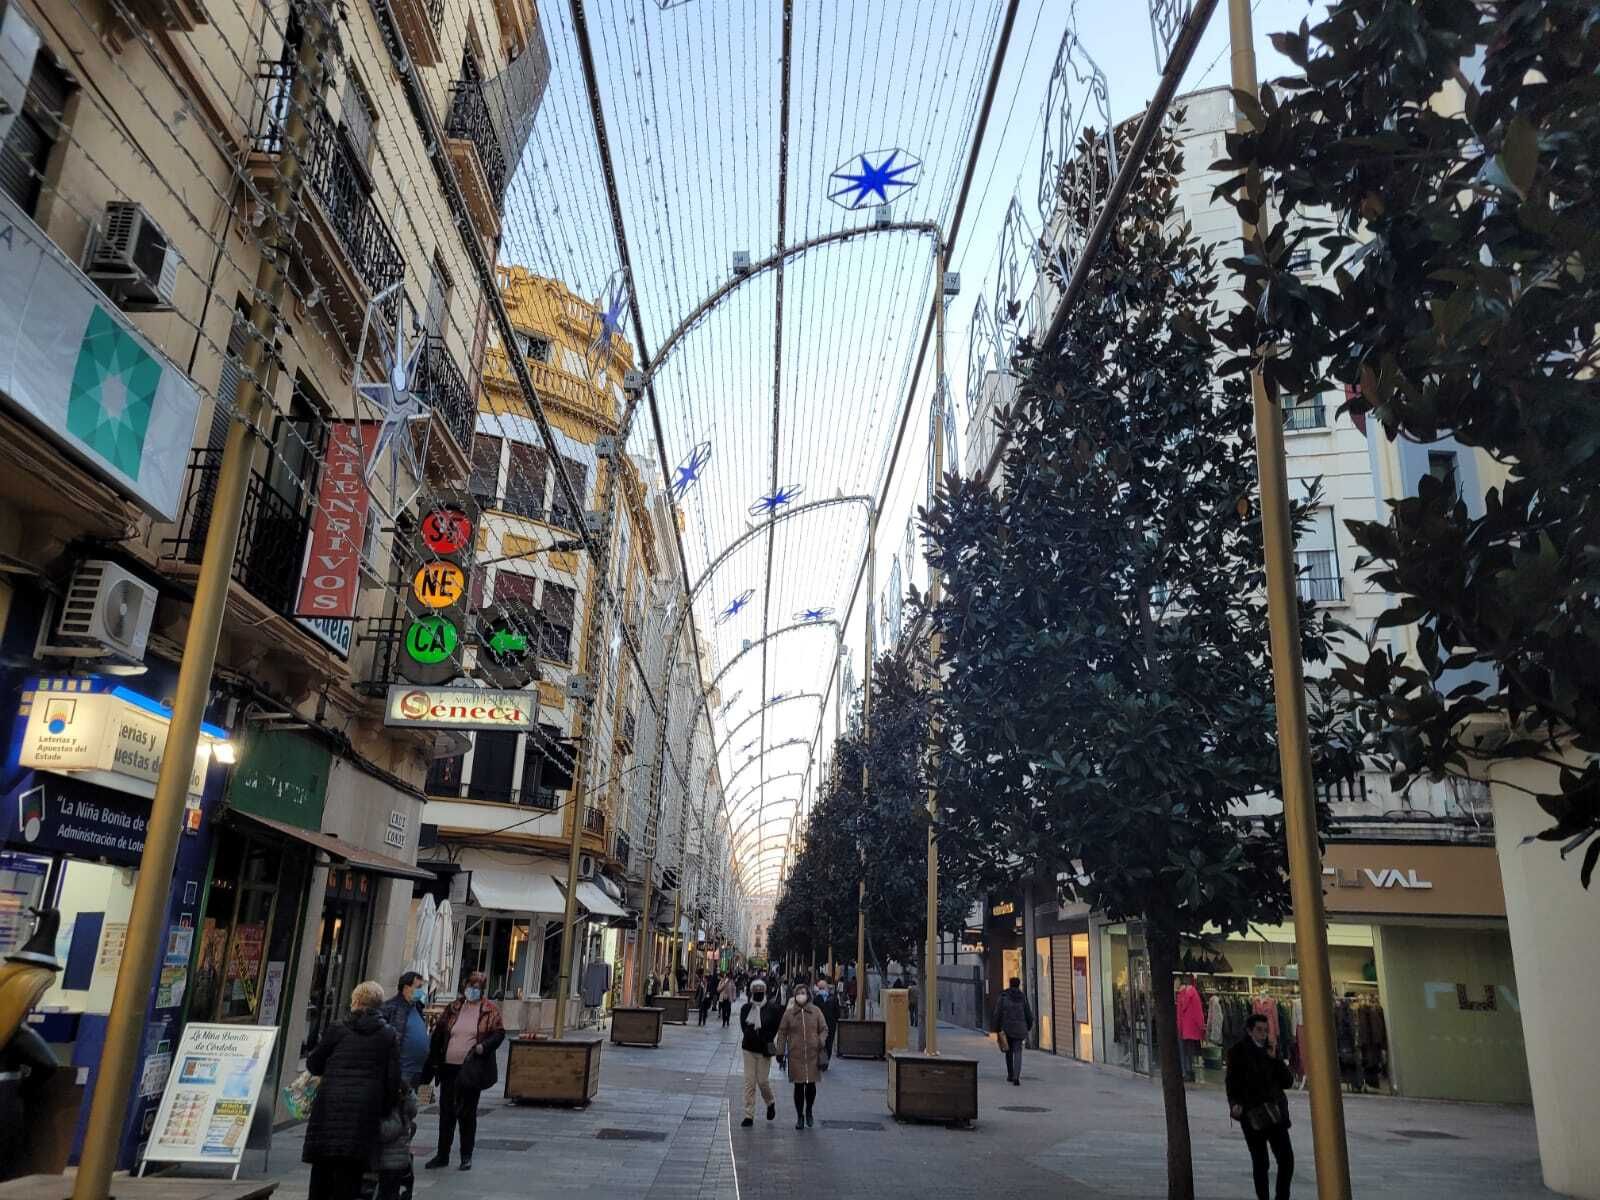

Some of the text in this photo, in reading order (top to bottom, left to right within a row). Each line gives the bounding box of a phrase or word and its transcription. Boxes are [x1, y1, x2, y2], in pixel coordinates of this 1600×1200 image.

[421, 568, 457, 598] NE
[414, 625, 446, 653] CA
[35, 752, 62, 761] Estado
[37, 744, 87, 753] Apuestas del
[114, 742, 150, 770] uestas
[75, 800, 99, 821] Niña
[101, 807, 132, 828] Bonita
[133, 815, 145, 832] de
[57, 823, 144, 853] Administración de Lote
